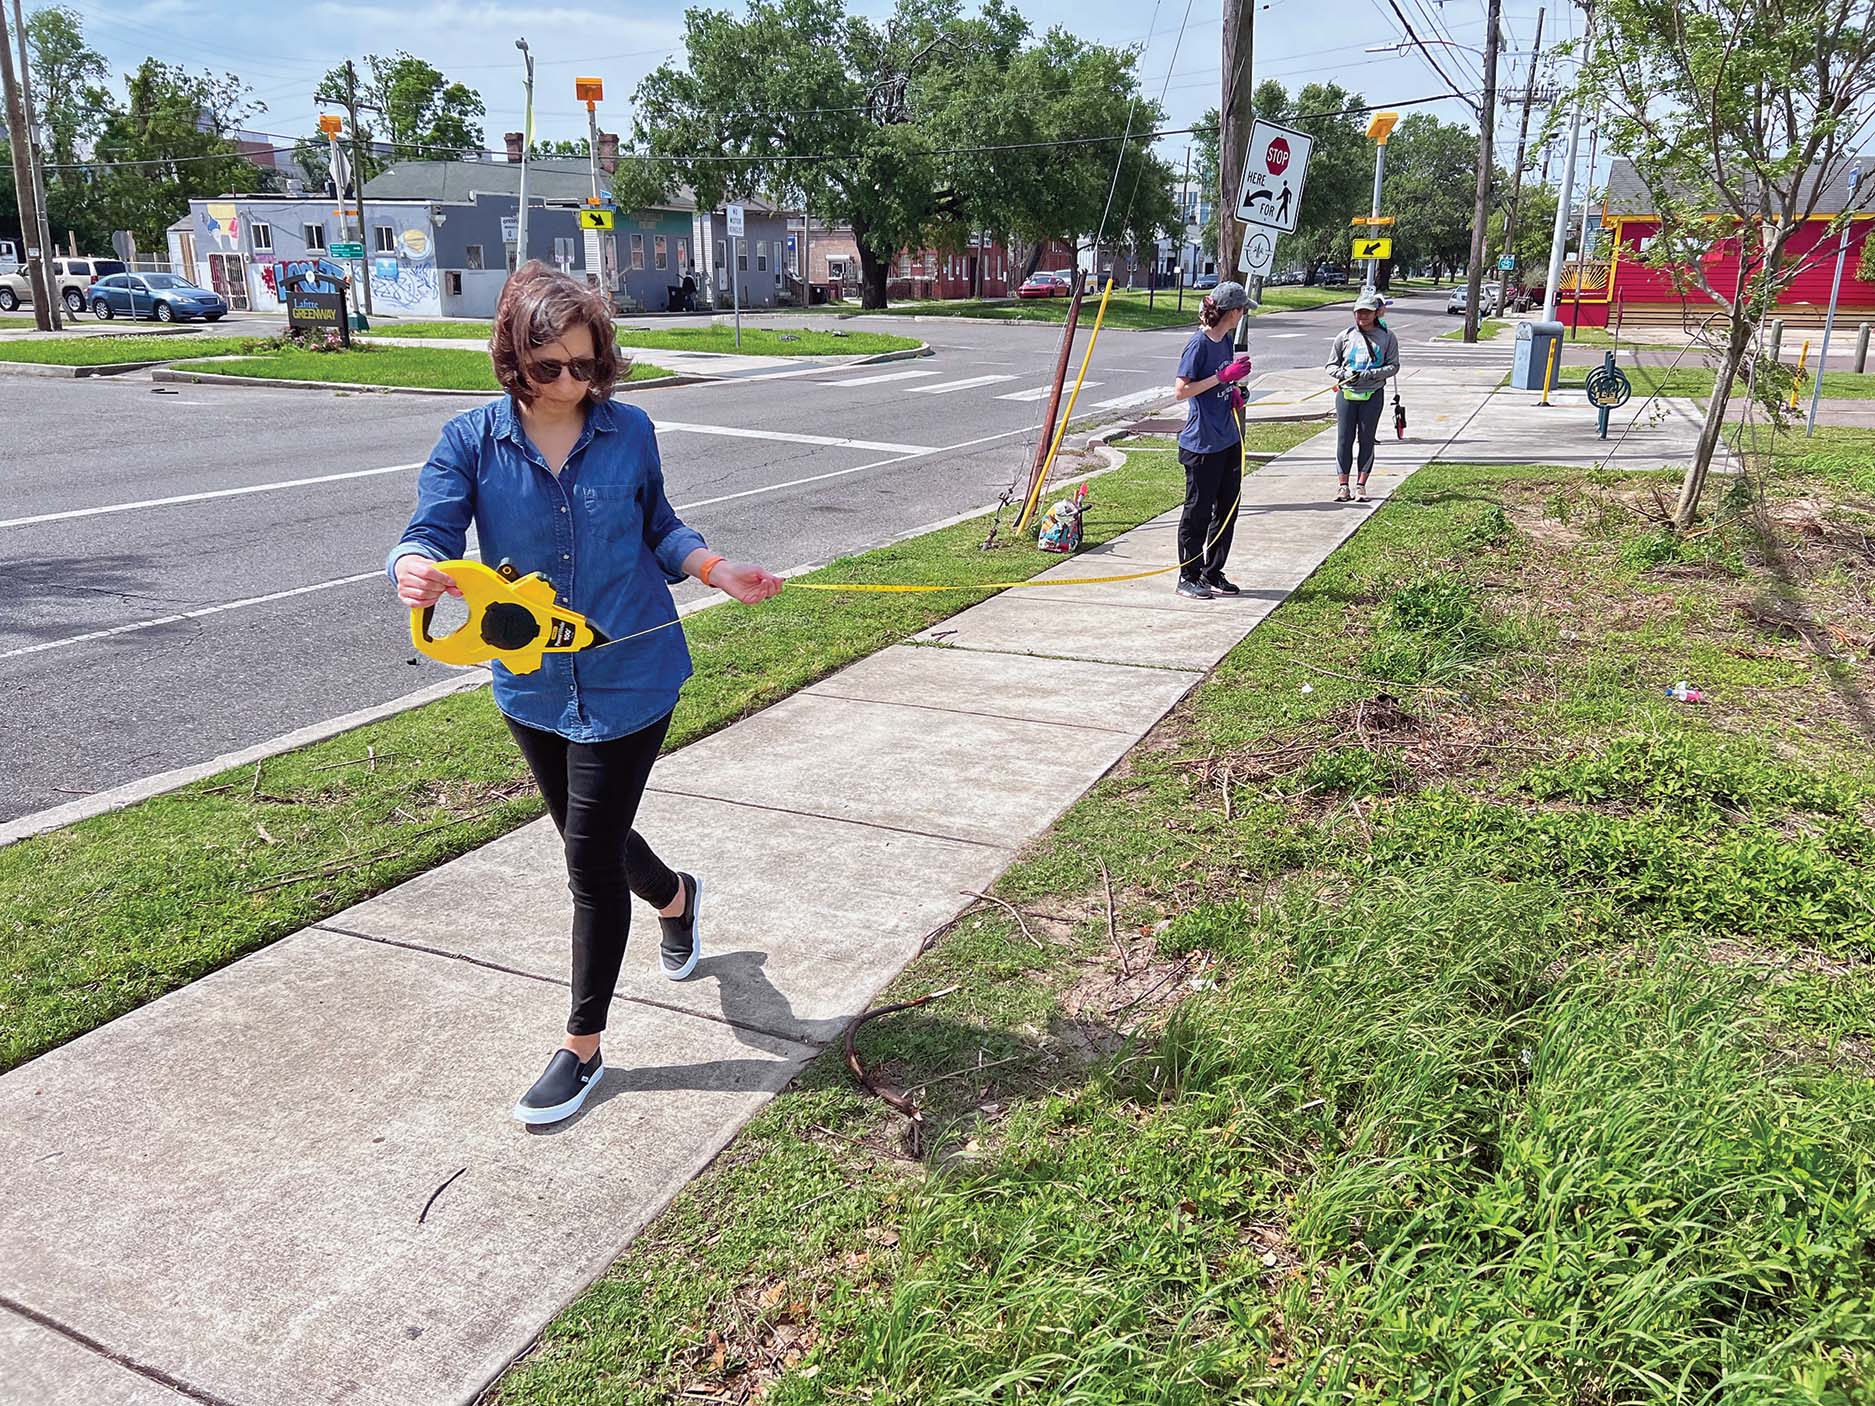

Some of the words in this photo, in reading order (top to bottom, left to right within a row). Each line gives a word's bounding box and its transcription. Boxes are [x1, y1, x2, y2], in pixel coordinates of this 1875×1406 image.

[1267, 147, 1289, 166] STOP
[1247, 171, 1266, 187] HERE
[1259, 203, 1275, 217] FOR
[294, 298, 319, 309] Lafitte
[292, 309, 337, 321] GREENWAY
